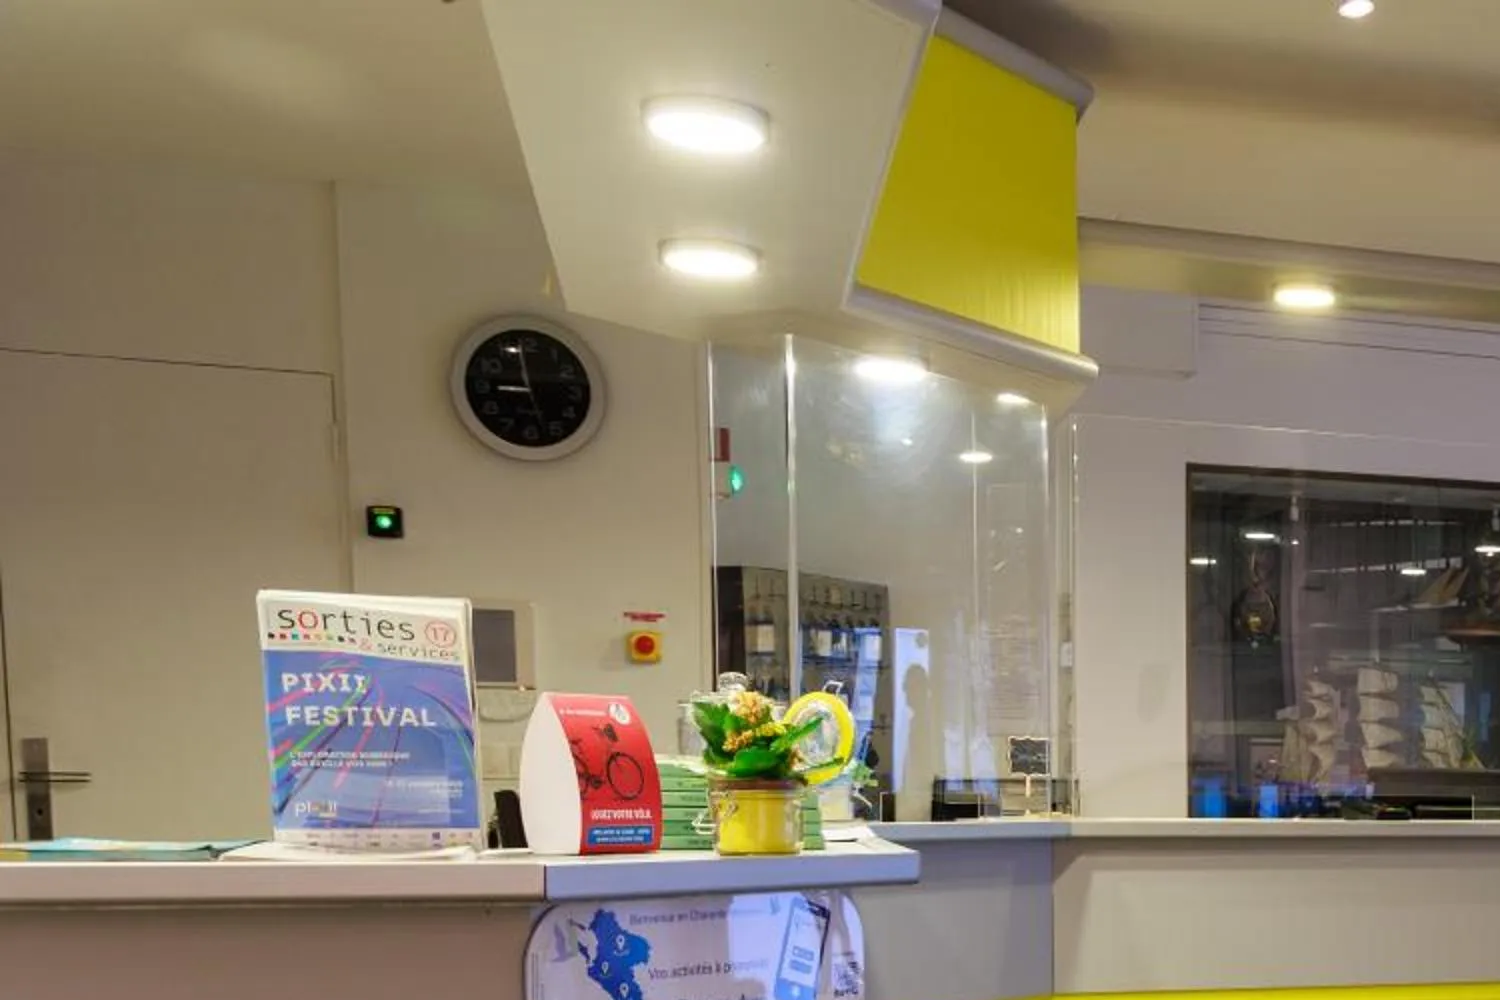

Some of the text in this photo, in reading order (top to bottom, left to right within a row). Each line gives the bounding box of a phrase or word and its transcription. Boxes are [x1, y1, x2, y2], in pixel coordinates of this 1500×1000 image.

[277, 608, 450, 641] sorties 17
[377, 641, 461, 661] services
[285, 705, 439, 727] FESTIVAL
